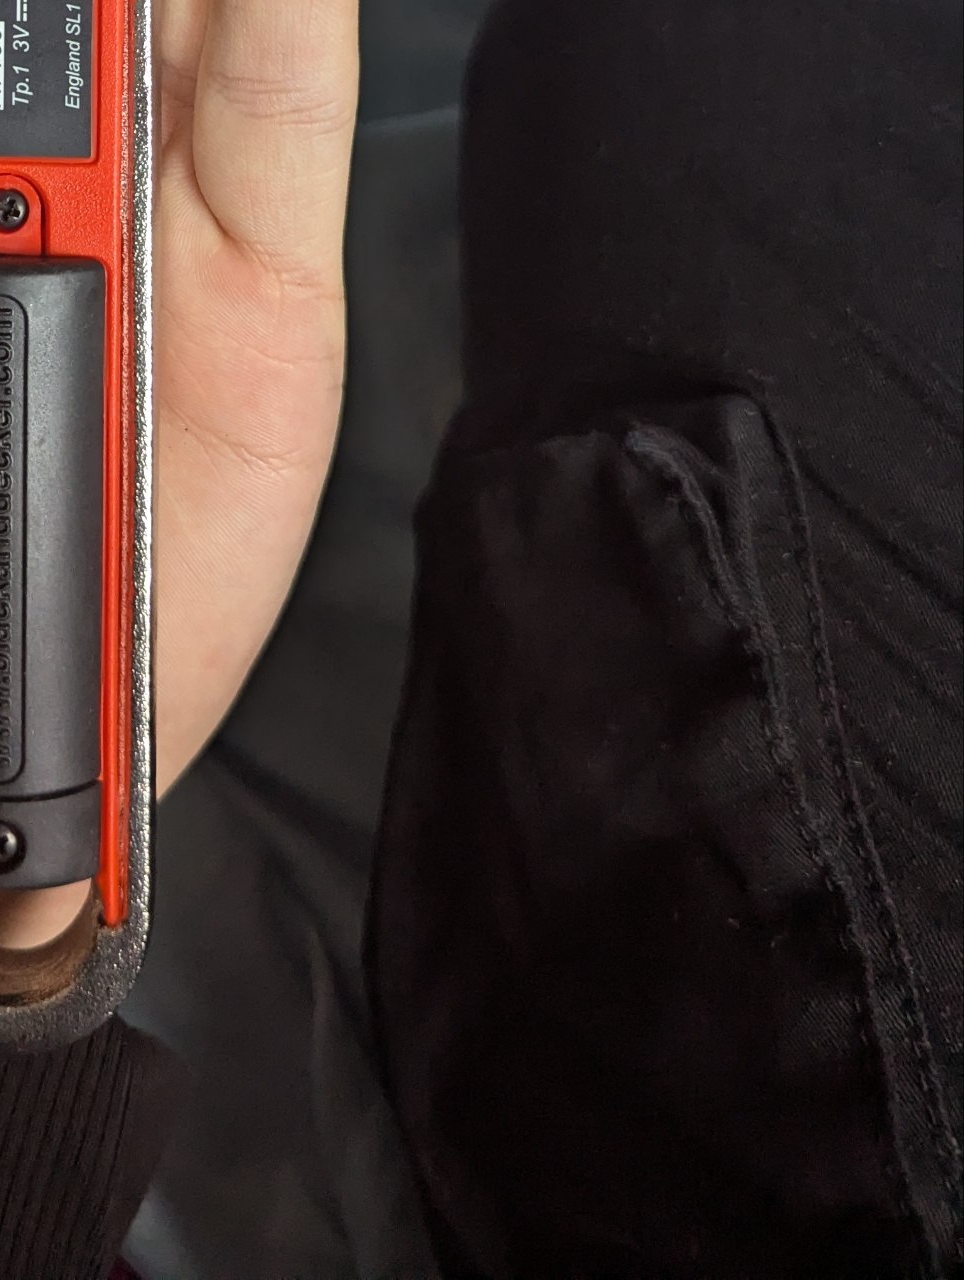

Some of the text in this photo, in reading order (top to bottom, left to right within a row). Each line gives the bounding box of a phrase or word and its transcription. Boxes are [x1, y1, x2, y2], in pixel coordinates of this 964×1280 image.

[66, 0, 82, 36] SL1
[12, 24, 30, 106] Tp.1 3V
[65, 39, 82, 110] England
